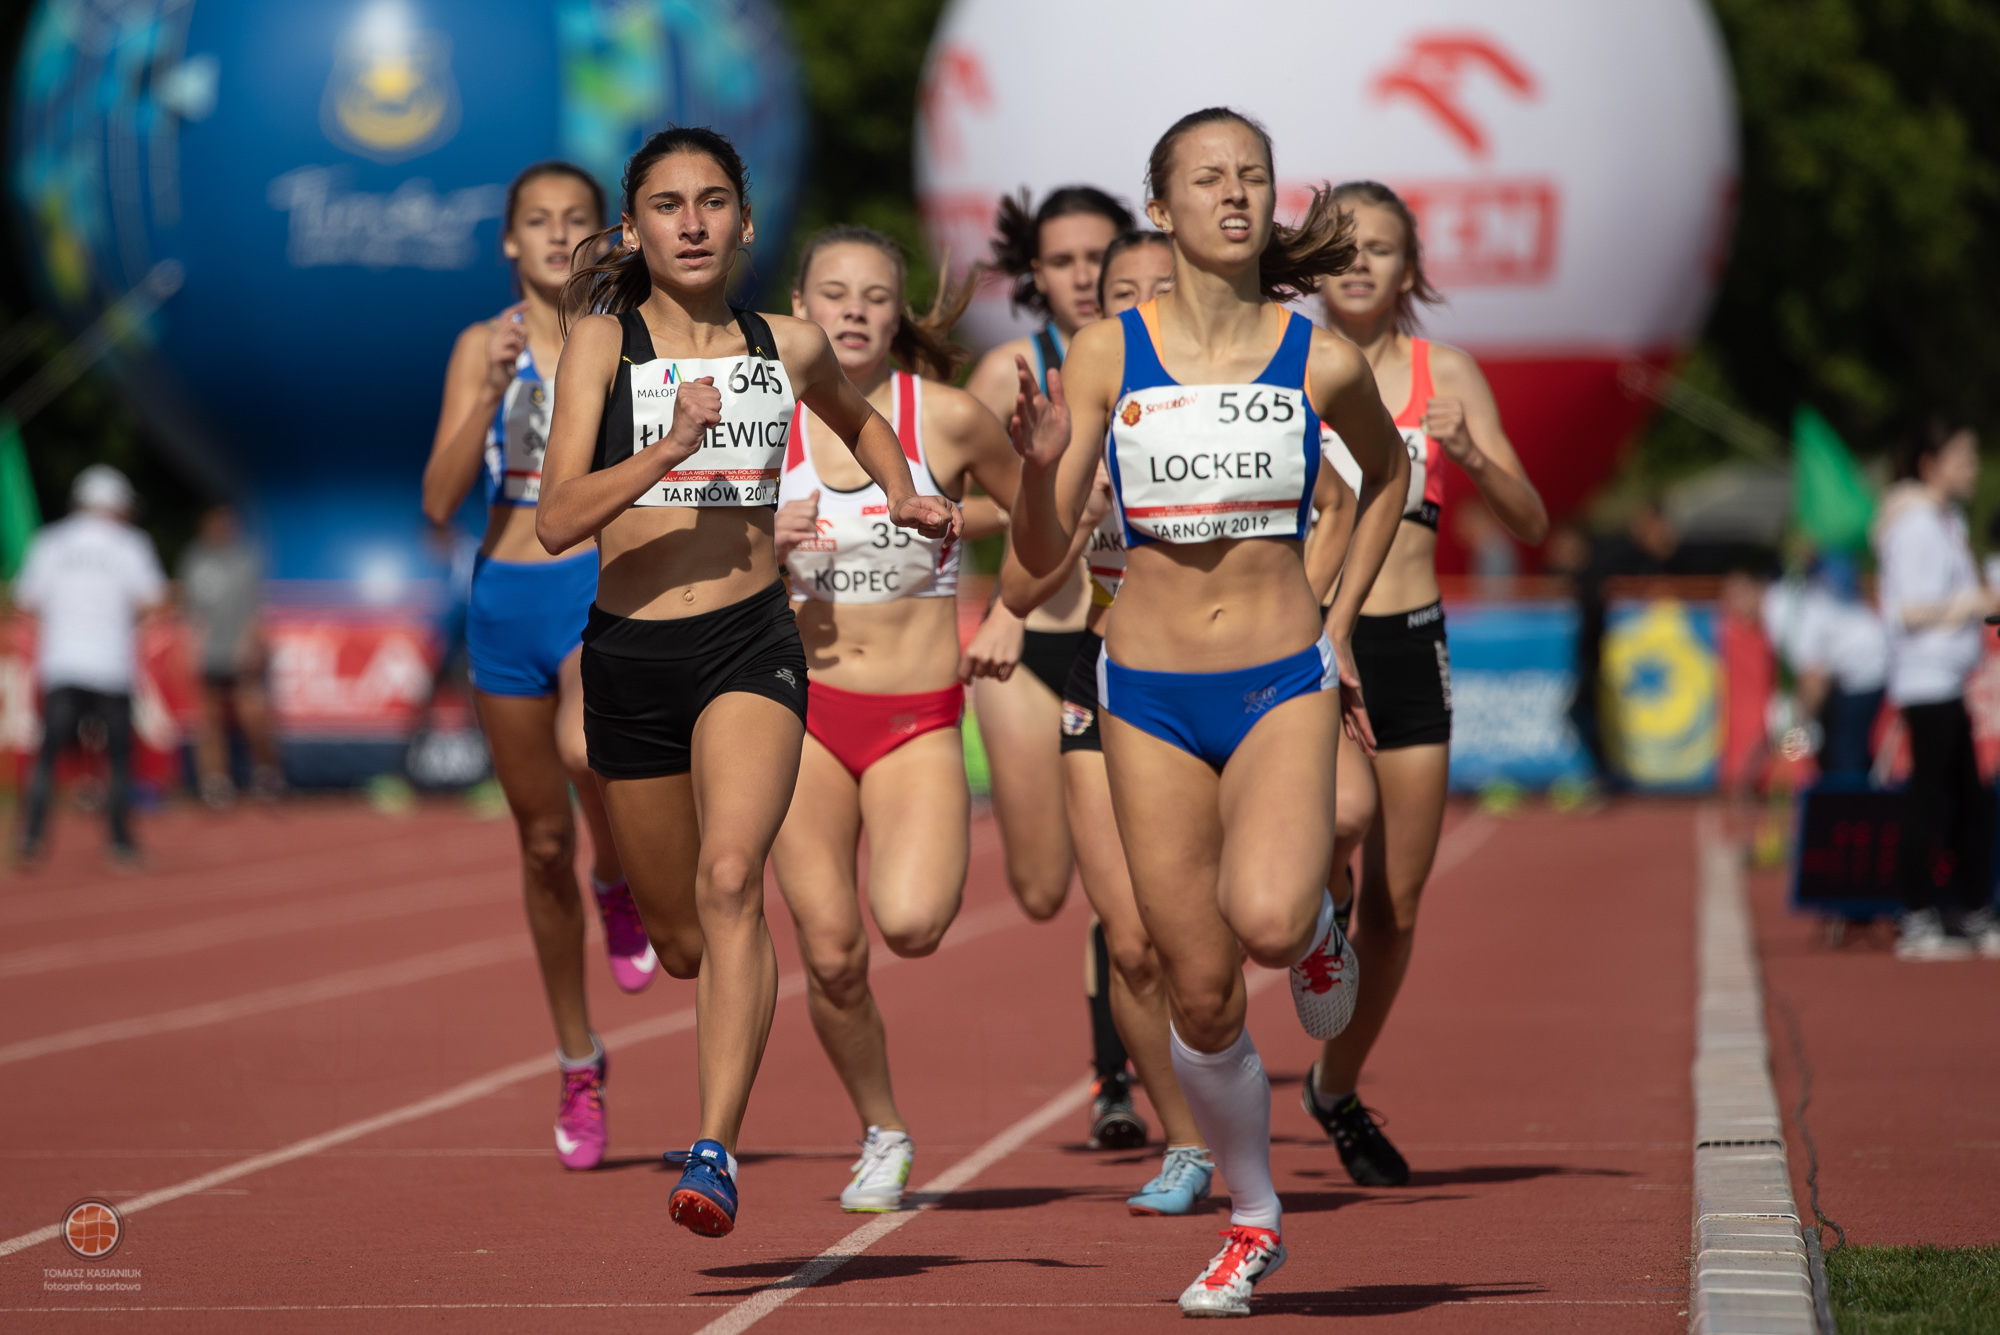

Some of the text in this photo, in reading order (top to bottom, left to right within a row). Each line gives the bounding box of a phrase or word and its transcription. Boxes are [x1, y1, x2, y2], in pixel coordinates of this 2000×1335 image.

[728, 362, 783, 394] 645
[637, 388, 676, 398] MAŁOP
[1218, 391, 1294, 424] 565
[1150, 451, 1273, 483] LOCKER
[662, 482, 739, 502] TARNÓW
[1152, 515, 1270, 539] TARNÓW 2019
[814, 566, 900, 592] KOPEĆ
